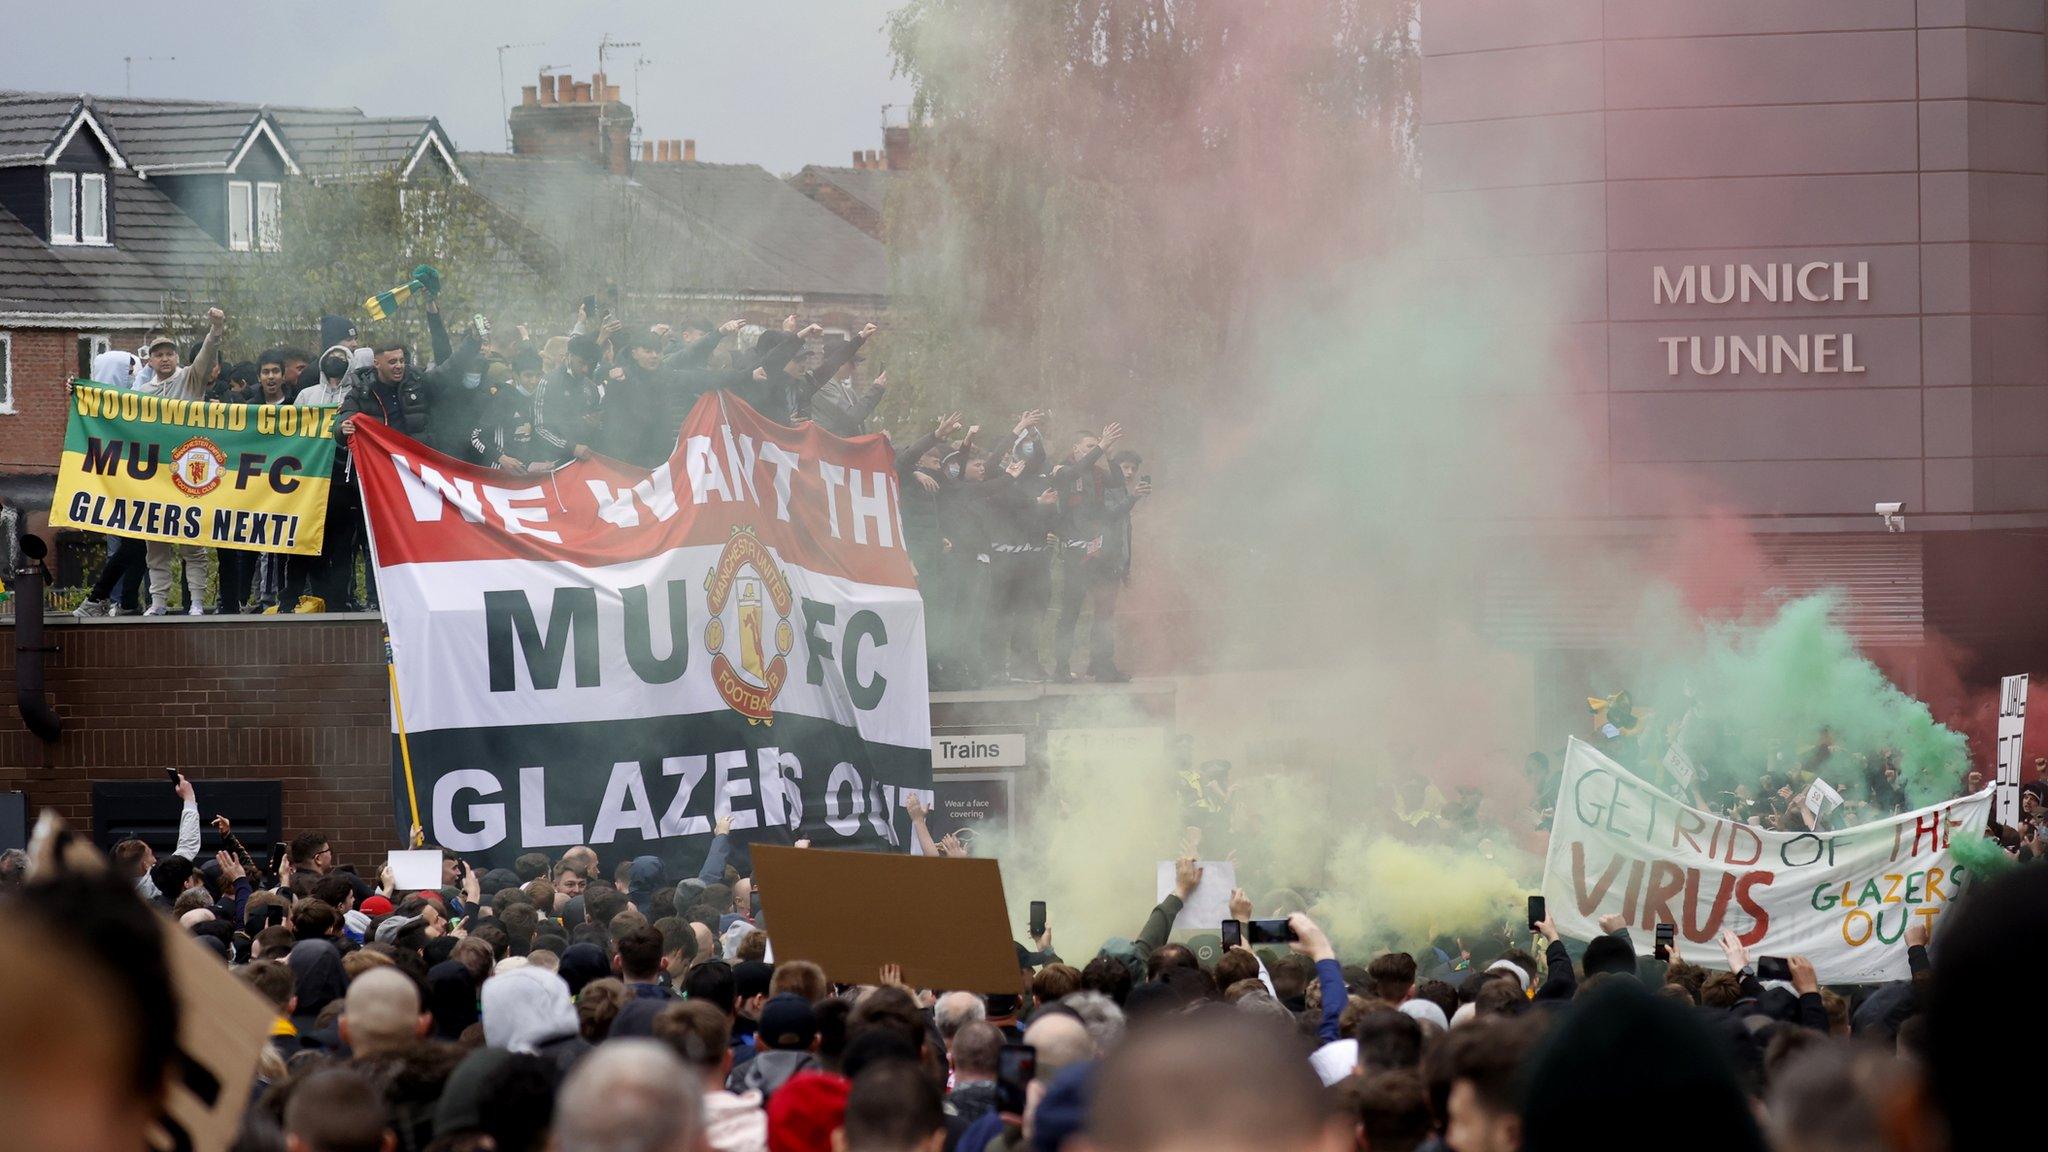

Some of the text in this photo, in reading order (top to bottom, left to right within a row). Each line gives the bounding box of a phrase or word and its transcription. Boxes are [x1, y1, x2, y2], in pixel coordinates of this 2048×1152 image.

[1653, 261, 1869, 304] MUNICH
[1658, 333, 1866, 376] TUNNEL
[76, 385, 337, 439] WOODWARD GONE
[81, 437, 303, 494] MU FC
[390, 424, 907, 551] WE WANT TH
[68, 491, 299, 547] GLAZERS NEXT!
[483, 579, 888, 711] MU FC
[939, 741, 1000, 759] Trains
[945, 800, 965, 808] Wear
[973, 800, 989, 808] face
[950, 810, 984, 819] covering
[1574, 768, 1664, 842] GET
[1672, 807, 1762, 866] RID
[1781, 833, 1852, 867] OF
[1571, 841, 1775, 948] VIRUS
[1811, 865, 1966, 911] GLAZERS
[1843, 907, 1941, 947] OUT
